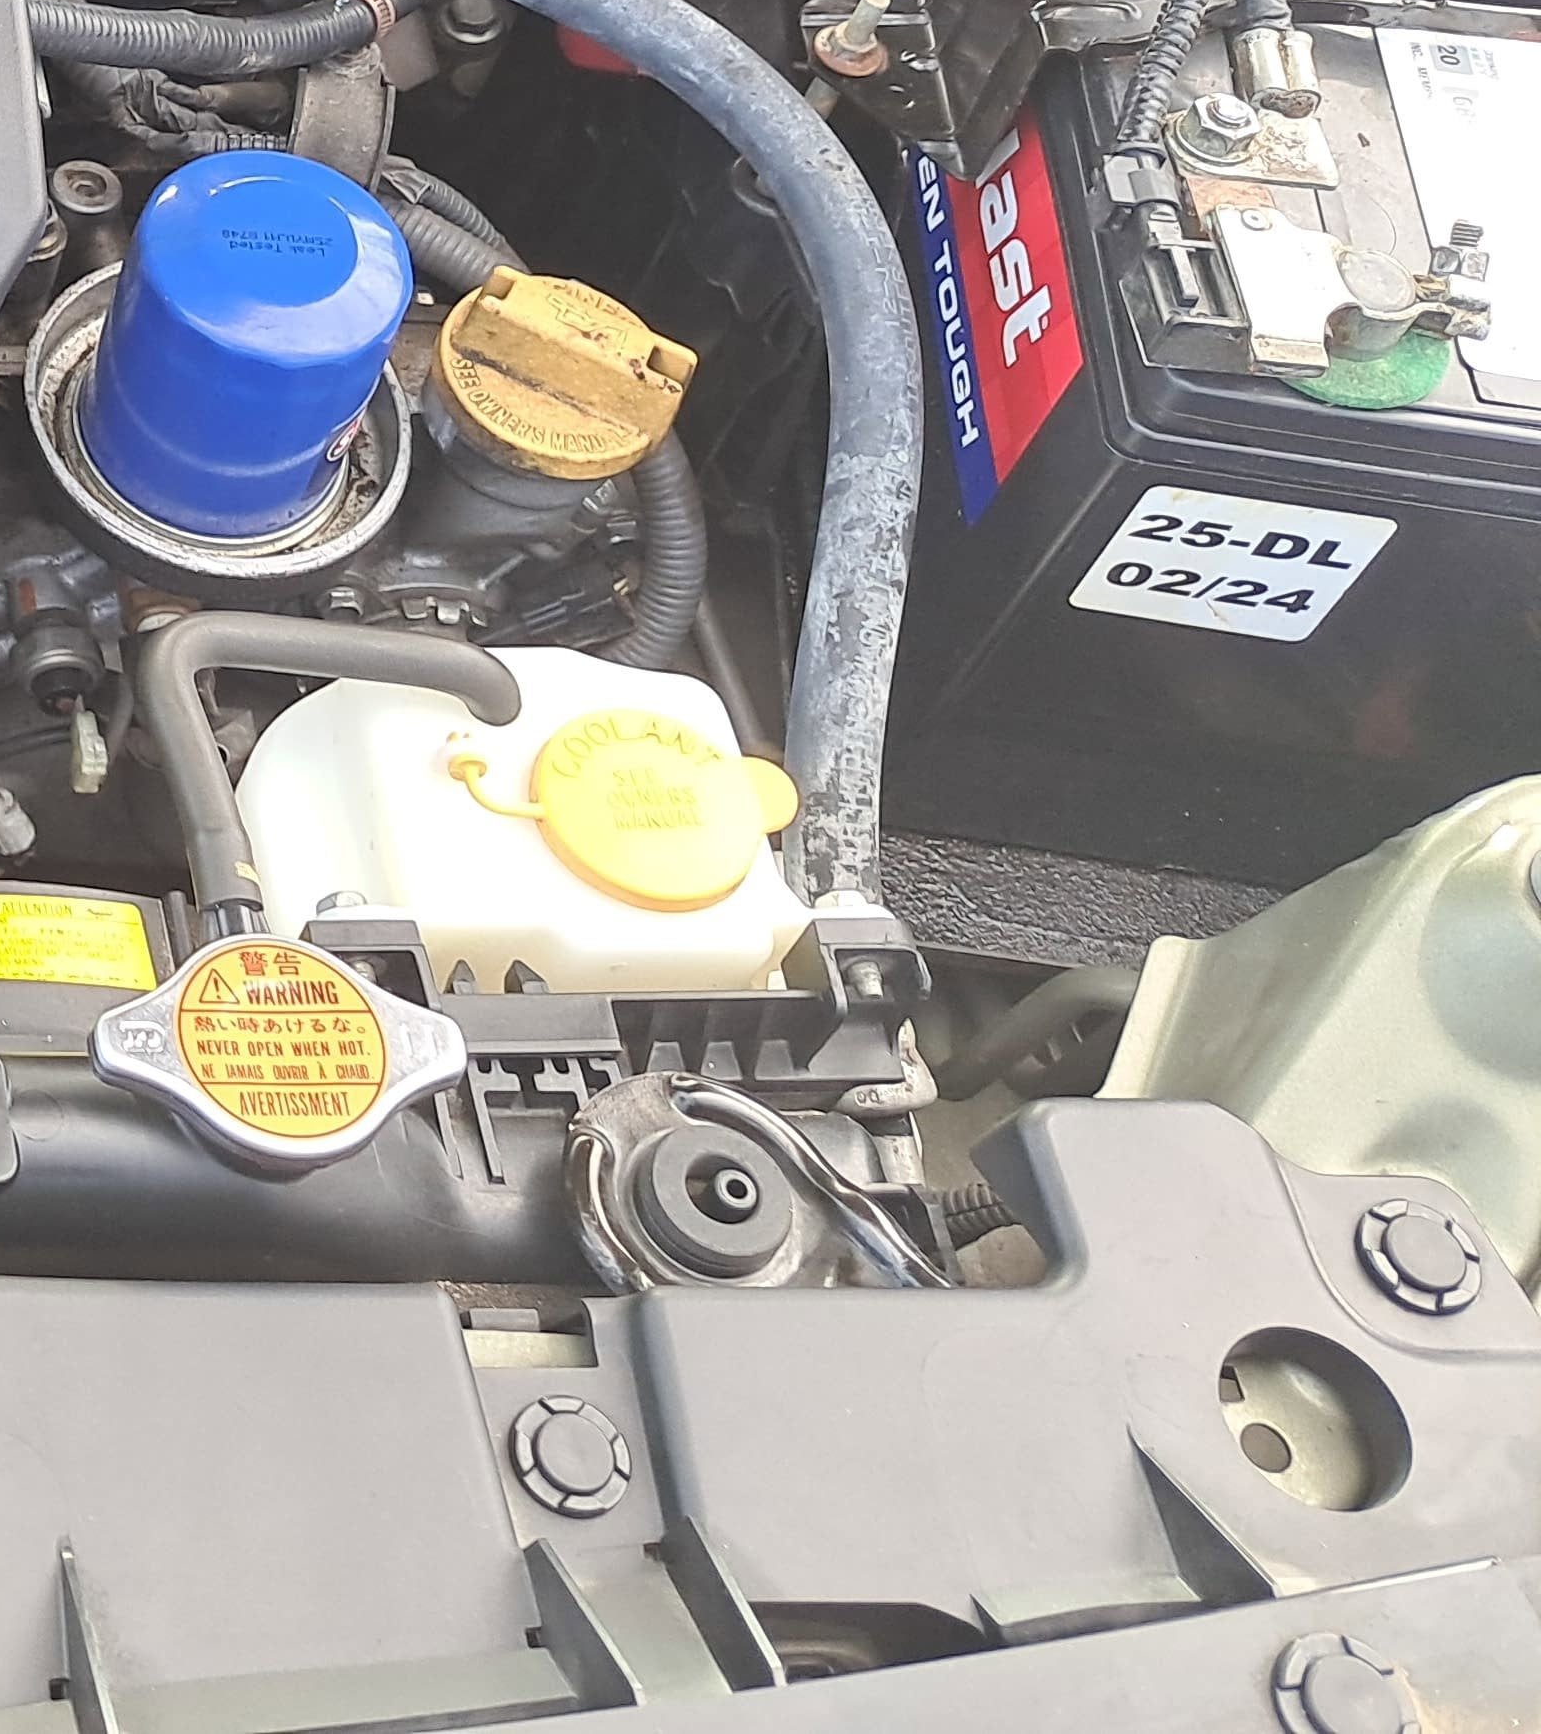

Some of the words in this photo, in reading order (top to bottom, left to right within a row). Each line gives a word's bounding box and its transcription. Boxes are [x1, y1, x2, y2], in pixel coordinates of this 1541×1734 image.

[1436, 44, 1461, 66] 20
[974, 126, 1053, 368] last
[917, 153, 945, 233] EN
[933, 238, 981, 448] TOUGH
[451, 358, 481, 390] SEE
[468, 389, 546, 445] OWNER'S
[1127, 514, 1353, 570] 25-DL
[1106, 562, 1316, 614] 02/24
[551, 716, 723, 778] COOLANT
[2, 902, 73, 915] ATTENTION
[239, 951, 302, 976] 警告
[243, 980, 340, 1005] WARNING
[197, 1040, 241, 1056] NEVER
[248, 1041, 284, 1056] OPEN
[291, 1041, 331, 1056] WHEN
[338, 1040, 371, 1056] HOT.
[201, 1064, 216, 1079] NE
[272, 1065, 310, 1080] OUVRIR
[239, 1091, 351, 1116] AVERTISSMENT
